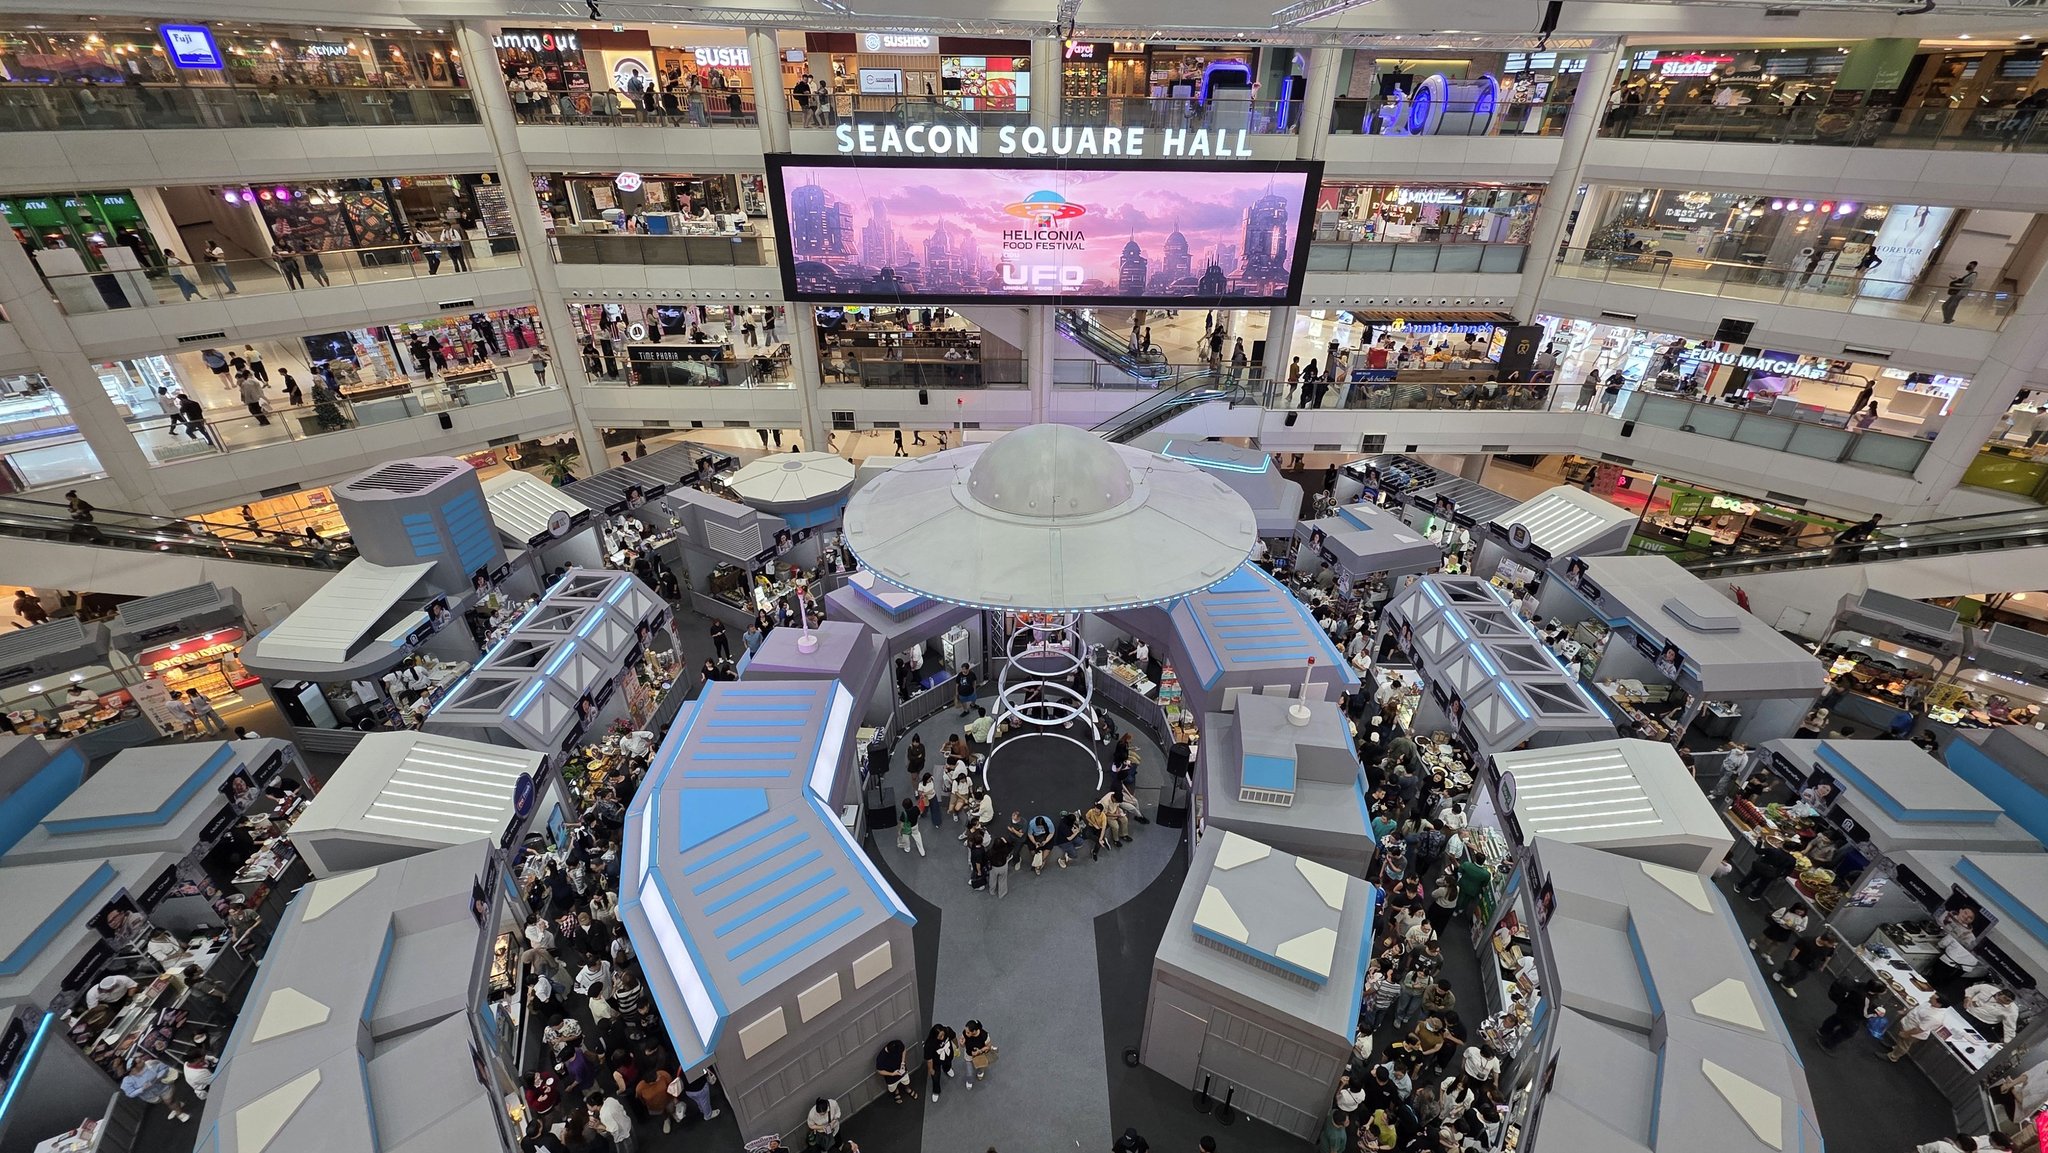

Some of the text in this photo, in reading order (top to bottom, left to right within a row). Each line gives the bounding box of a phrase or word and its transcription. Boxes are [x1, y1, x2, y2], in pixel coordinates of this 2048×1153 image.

[173, 33, 193, 45] Fuji
[883, 35, 930, 48] SUSHIRO
[694, 47, 750, 66] SUSHI
[1660, 61, 1718, 76] Sizzler
[835, 123, 1253, 157] SEACON SQUARE HALL
[103, 197, 125, 205] ATM
[1408, 190, 1447, 204] MIXUE
[24, 201, 48, 210] ATM
[1003, 230, 1086, 242] HELICONIA
[1003, 241, 1086, 251] FOOD FESTIVAL
[1876, 245, 1922, 256] FOREVER
[1002, 264, 1085, 286] UFO
[1402, 322, 1494, 334] Auntie Anne's
[1737, 354, 1812, 380] MATCHA
